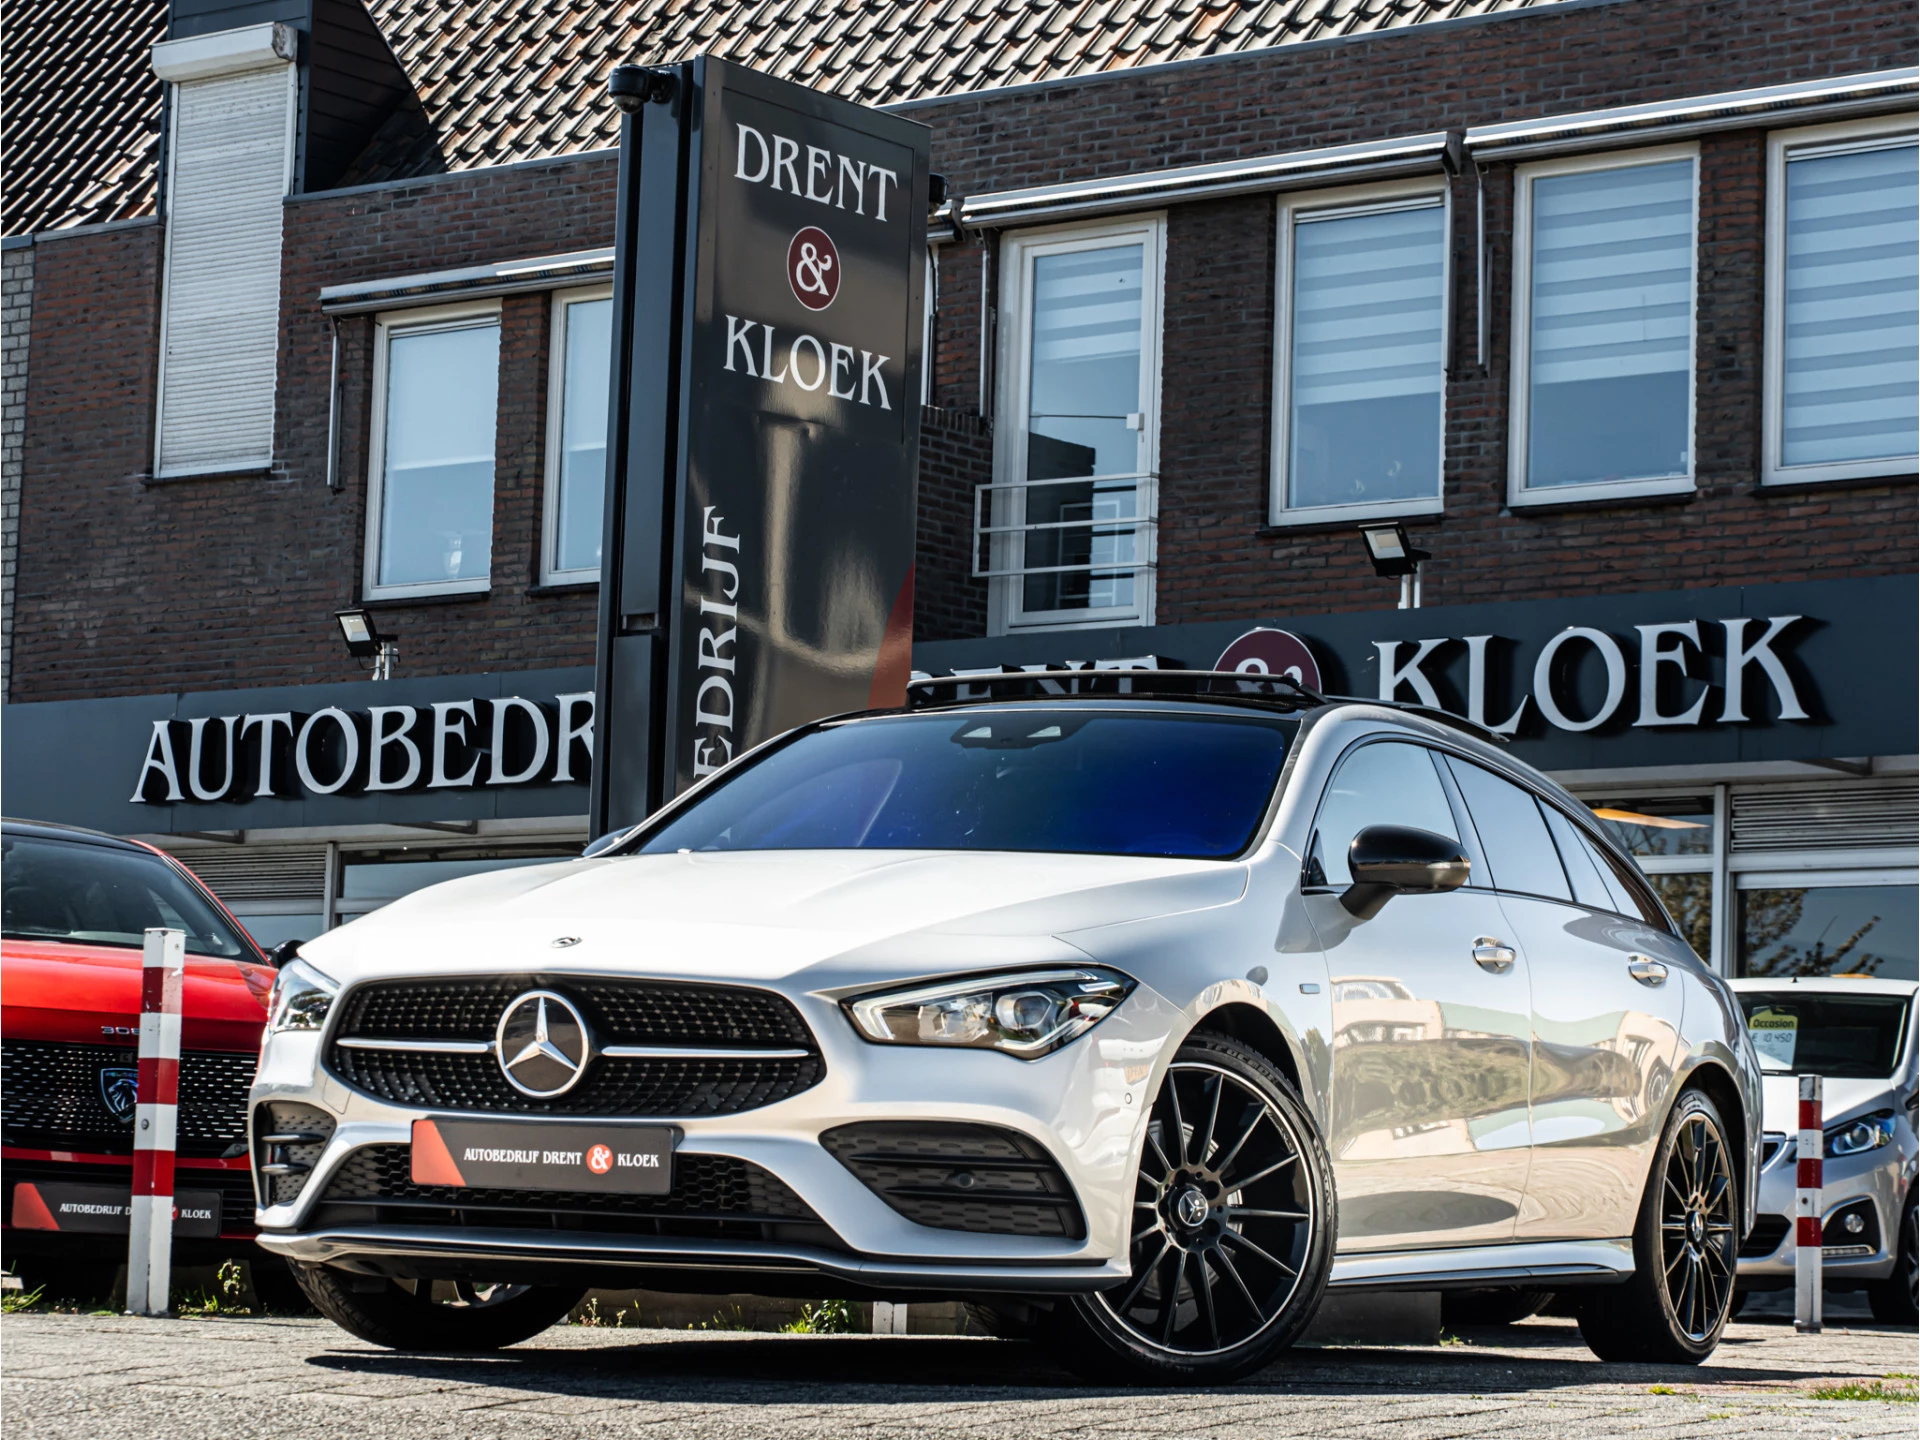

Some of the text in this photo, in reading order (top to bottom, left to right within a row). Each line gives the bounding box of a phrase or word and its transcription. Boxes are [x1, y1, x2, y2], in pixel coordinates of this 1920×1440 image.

[734, 123, 898, 222] DRENT
[795, 242, 832, 296] &
[723, 314, 892, 410] KLOEK
[1371, 615, 1810, 734] KLOEK
[1753, 1019, 1795, 1028] Occasion
[464, 1147, 659, 1169] AUTOBEDRIJF DRENT & KLOEK
[59, 1203, 123, 1215] AUTOBEDRIJF
[181, 1209, 212, 1219] KLOEK
